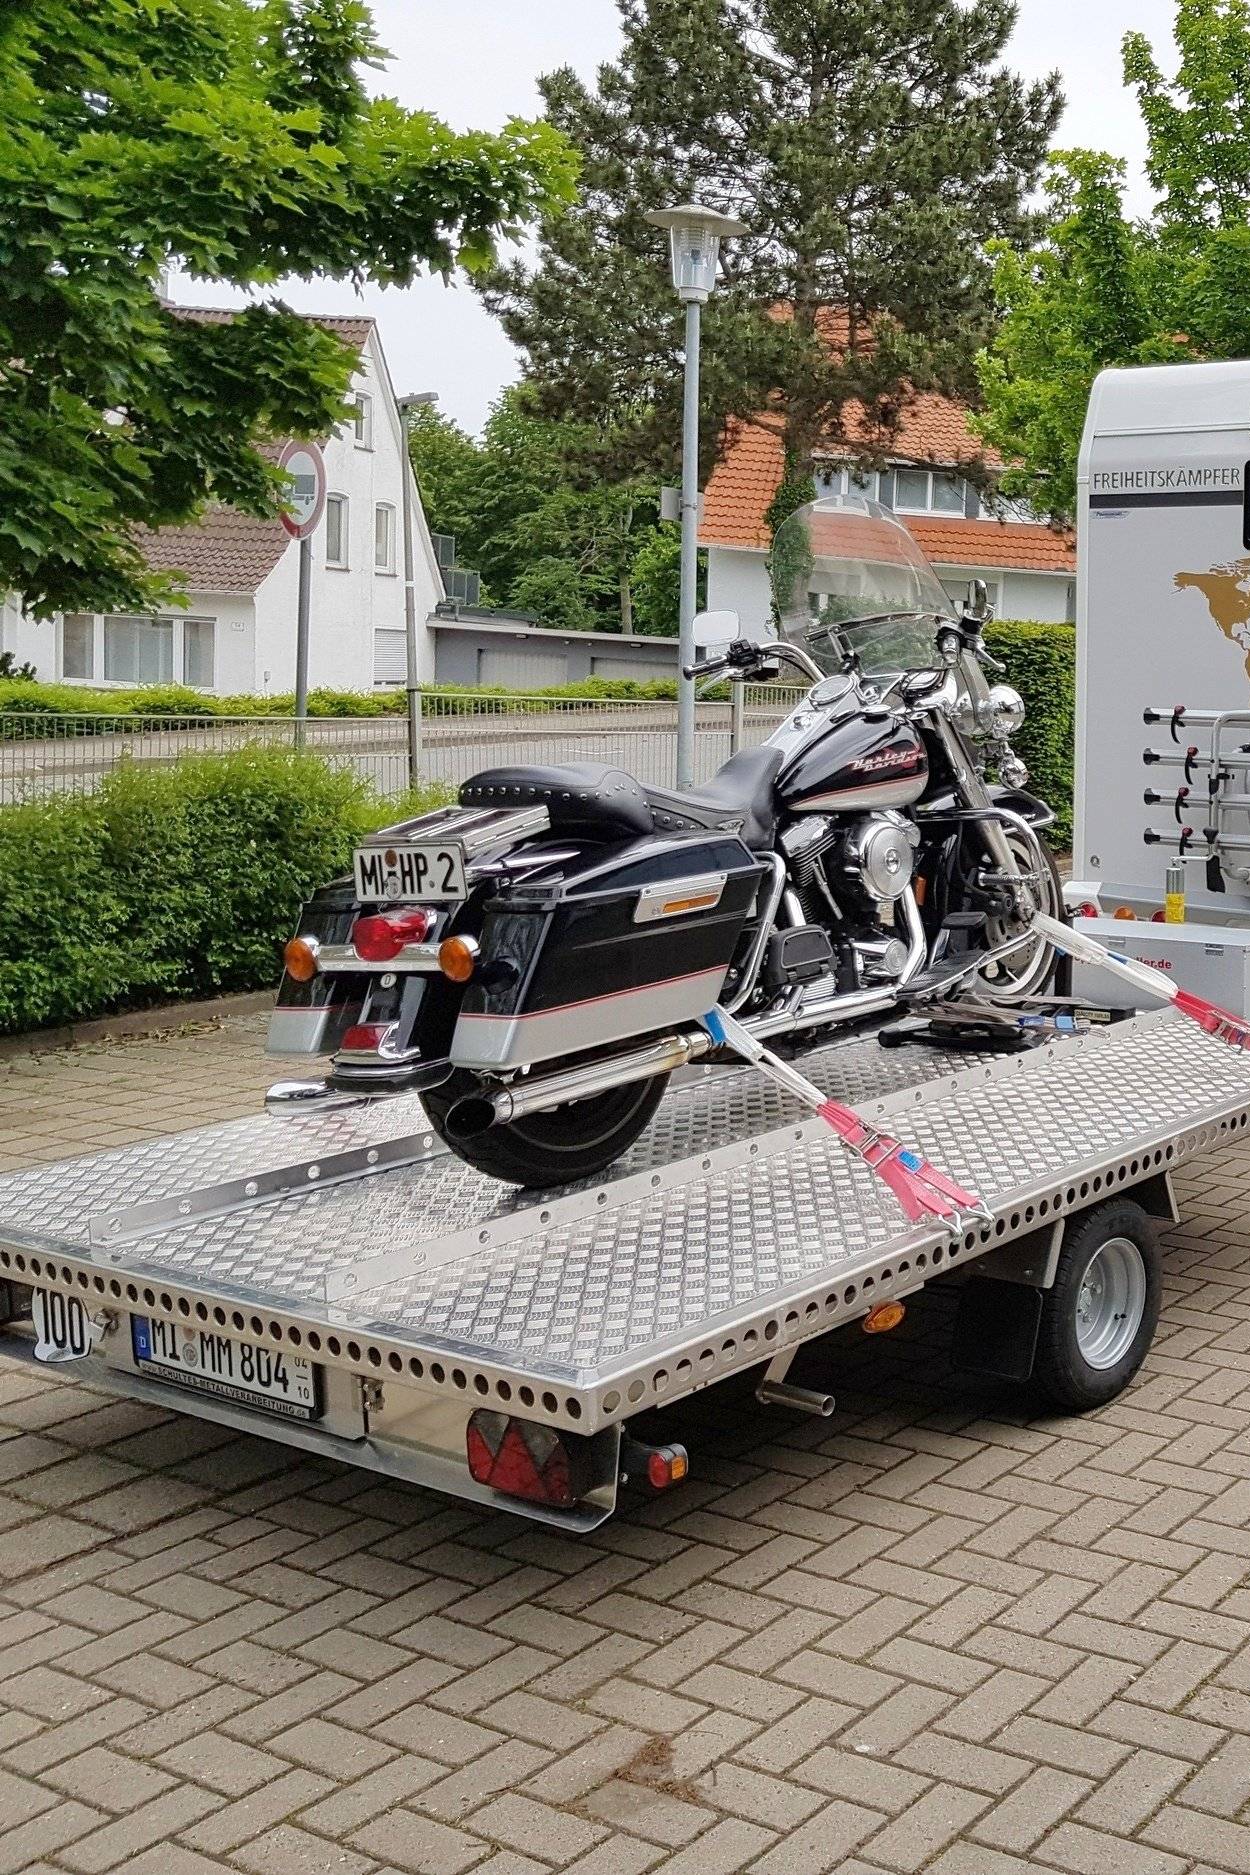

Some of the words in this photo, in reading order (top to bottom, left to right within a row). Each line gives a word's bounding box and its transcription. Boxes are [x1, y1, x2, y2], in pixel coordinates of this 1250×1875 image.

[1093, 465, 1240, 490] FREIHEITSKÄMPFER
[437, 852, 459, 893] 2
[36, 1286, 86, 1356] 100
[151, 1318, 180, 1361] MI
[200, 1331, 233, 1377] MM
[240, 1342, 289, 1393] 804
